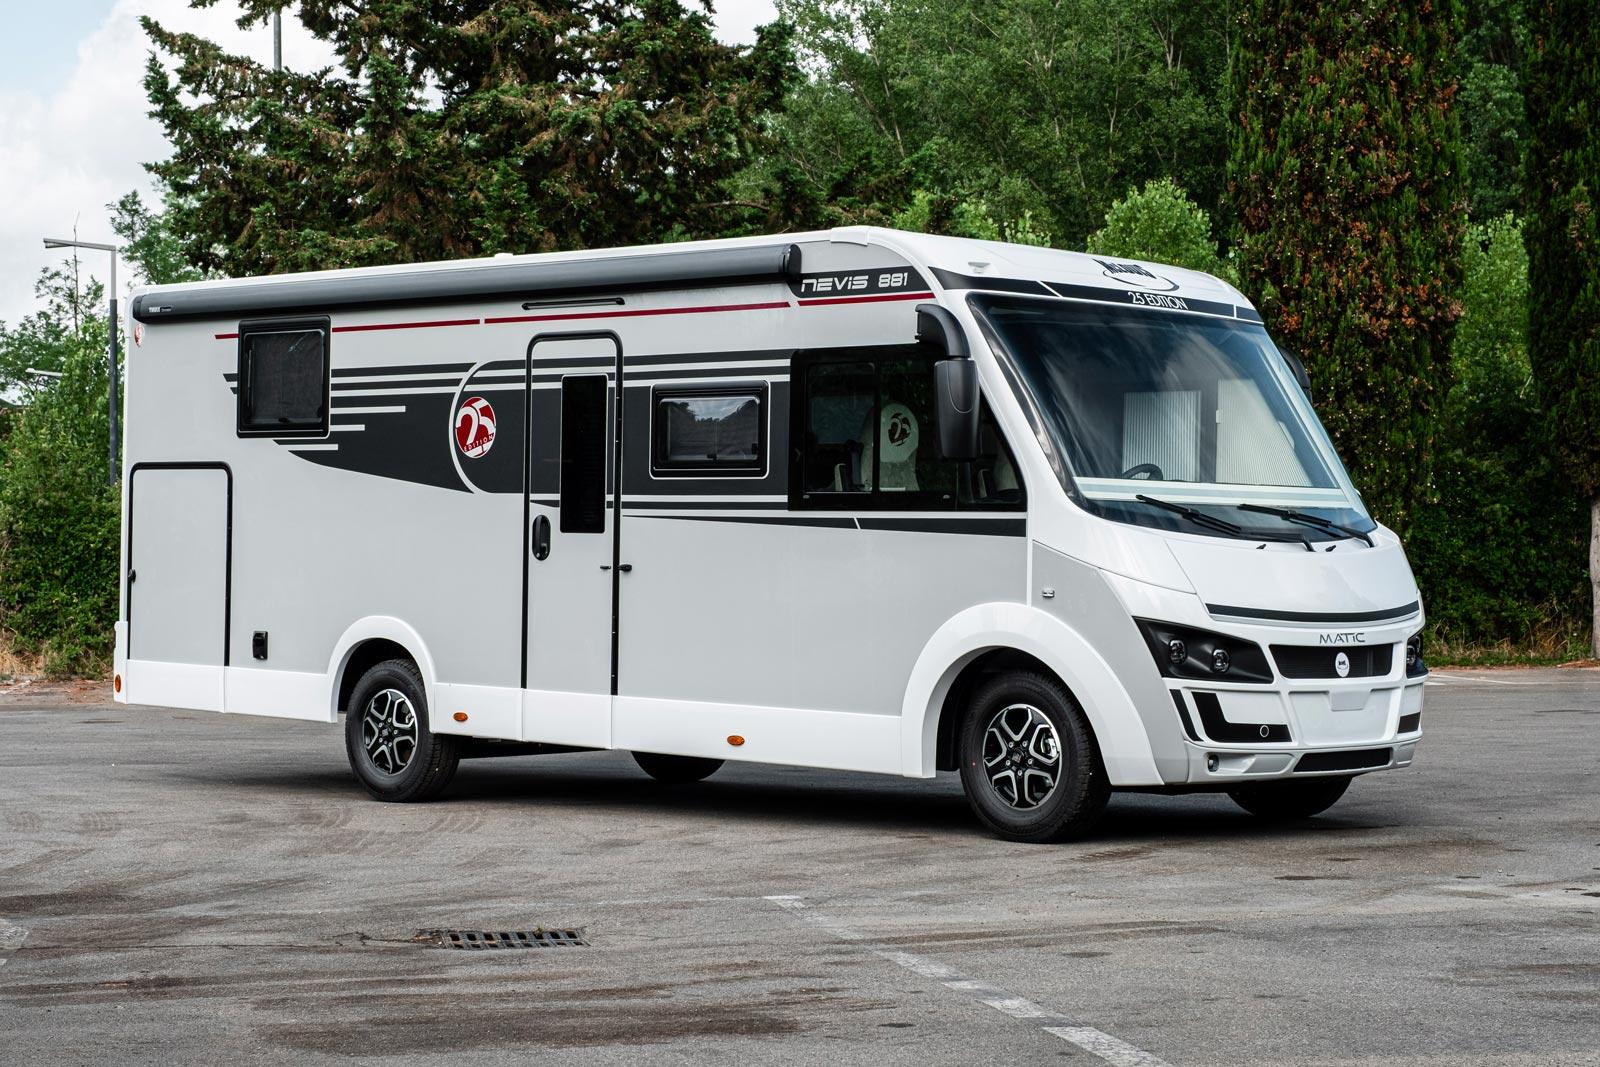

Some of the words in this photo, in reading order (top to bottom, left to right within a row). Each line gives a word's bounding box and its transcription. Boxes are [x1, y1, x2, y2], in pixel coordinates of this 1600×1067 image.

[878, 272, 908, 288] 881
[1128, 291, 1145, 305] 25
[1143, 293, 1189, 310] EDITION
[455, 399, 496, 456] 25
[463, 433, 494, 452] EDITION
[1319, 632, 1366, 645] MATIC
